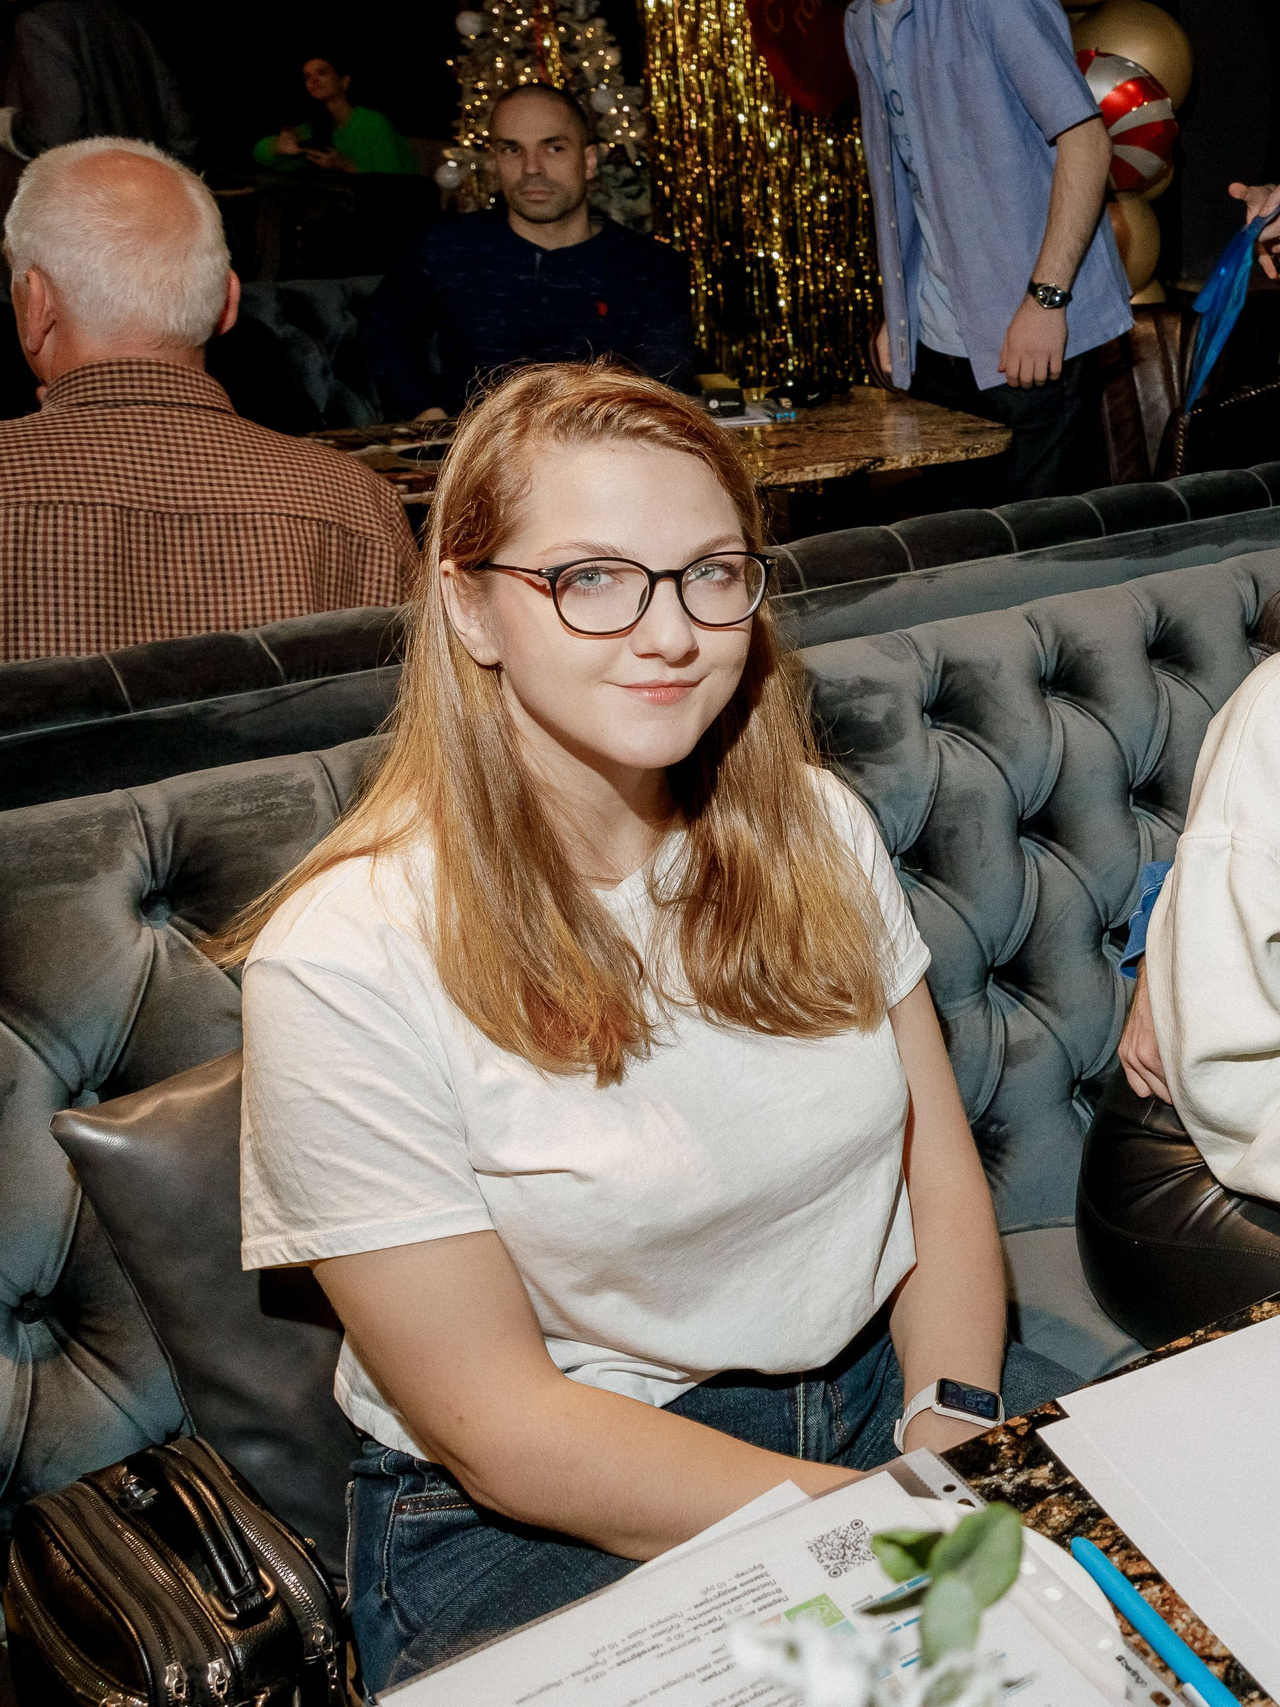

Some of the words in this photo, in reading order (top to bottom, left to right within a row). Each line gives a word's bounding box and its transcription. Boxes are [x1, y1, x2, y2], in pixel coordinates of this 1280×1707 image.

[732, 1559, 765, 1581] Бустер
[737, 1568, 771, 1590] Замена
[691, 1582, 739, 1611] индустрии
[750, 1584, 783, 1605] Вторая
[755, 1592, 789, 1614] Первая
[647, 1607, 684, 1631] Пропуск
[690, 1611, 724, 1633] Третья
[649, 1620, 682, 1641] Кубики
[613, 1638, 644, 1658] Шкала
[614, 1640, 663, 1669] Четвёртая
[569, 1656, 608, 1679] Рулетка
[659, 1669, 697, 1693] бустера
